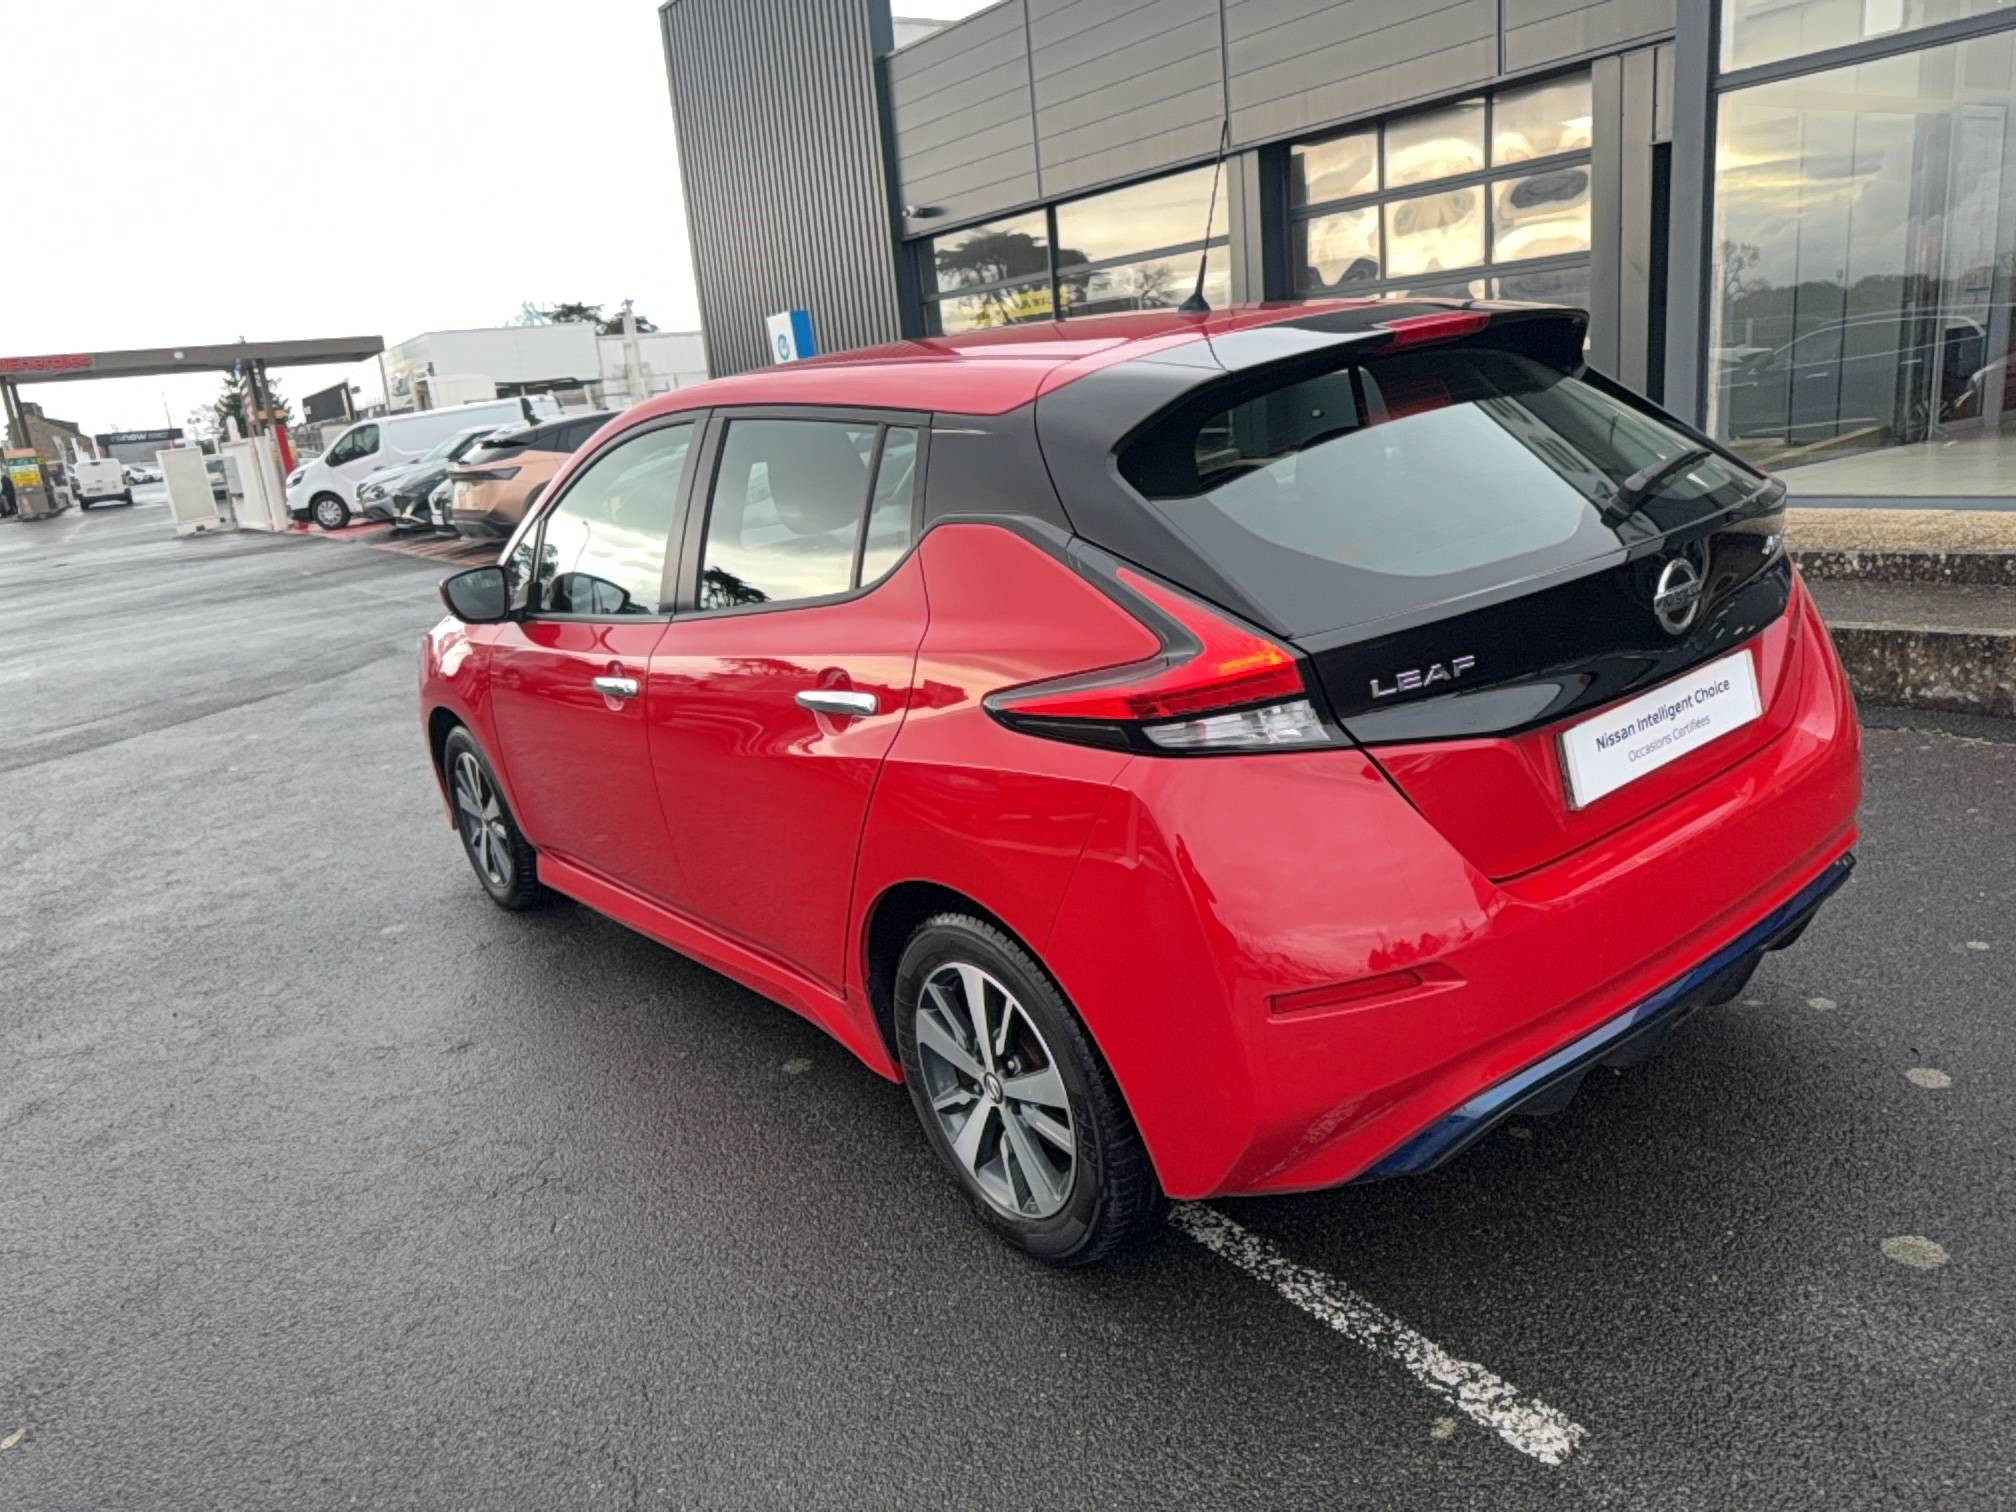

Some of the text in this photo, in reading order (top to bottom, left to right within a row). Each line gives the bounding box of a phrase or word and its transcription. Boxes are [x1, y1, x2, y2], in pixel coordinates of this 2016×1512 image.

[1369, 655, 1475, 699] LEAF
[1595, 679, 1730, 752] Nissan Intelligent Choice
[1628, 714, 1712, 763] Occasions Certifiées
